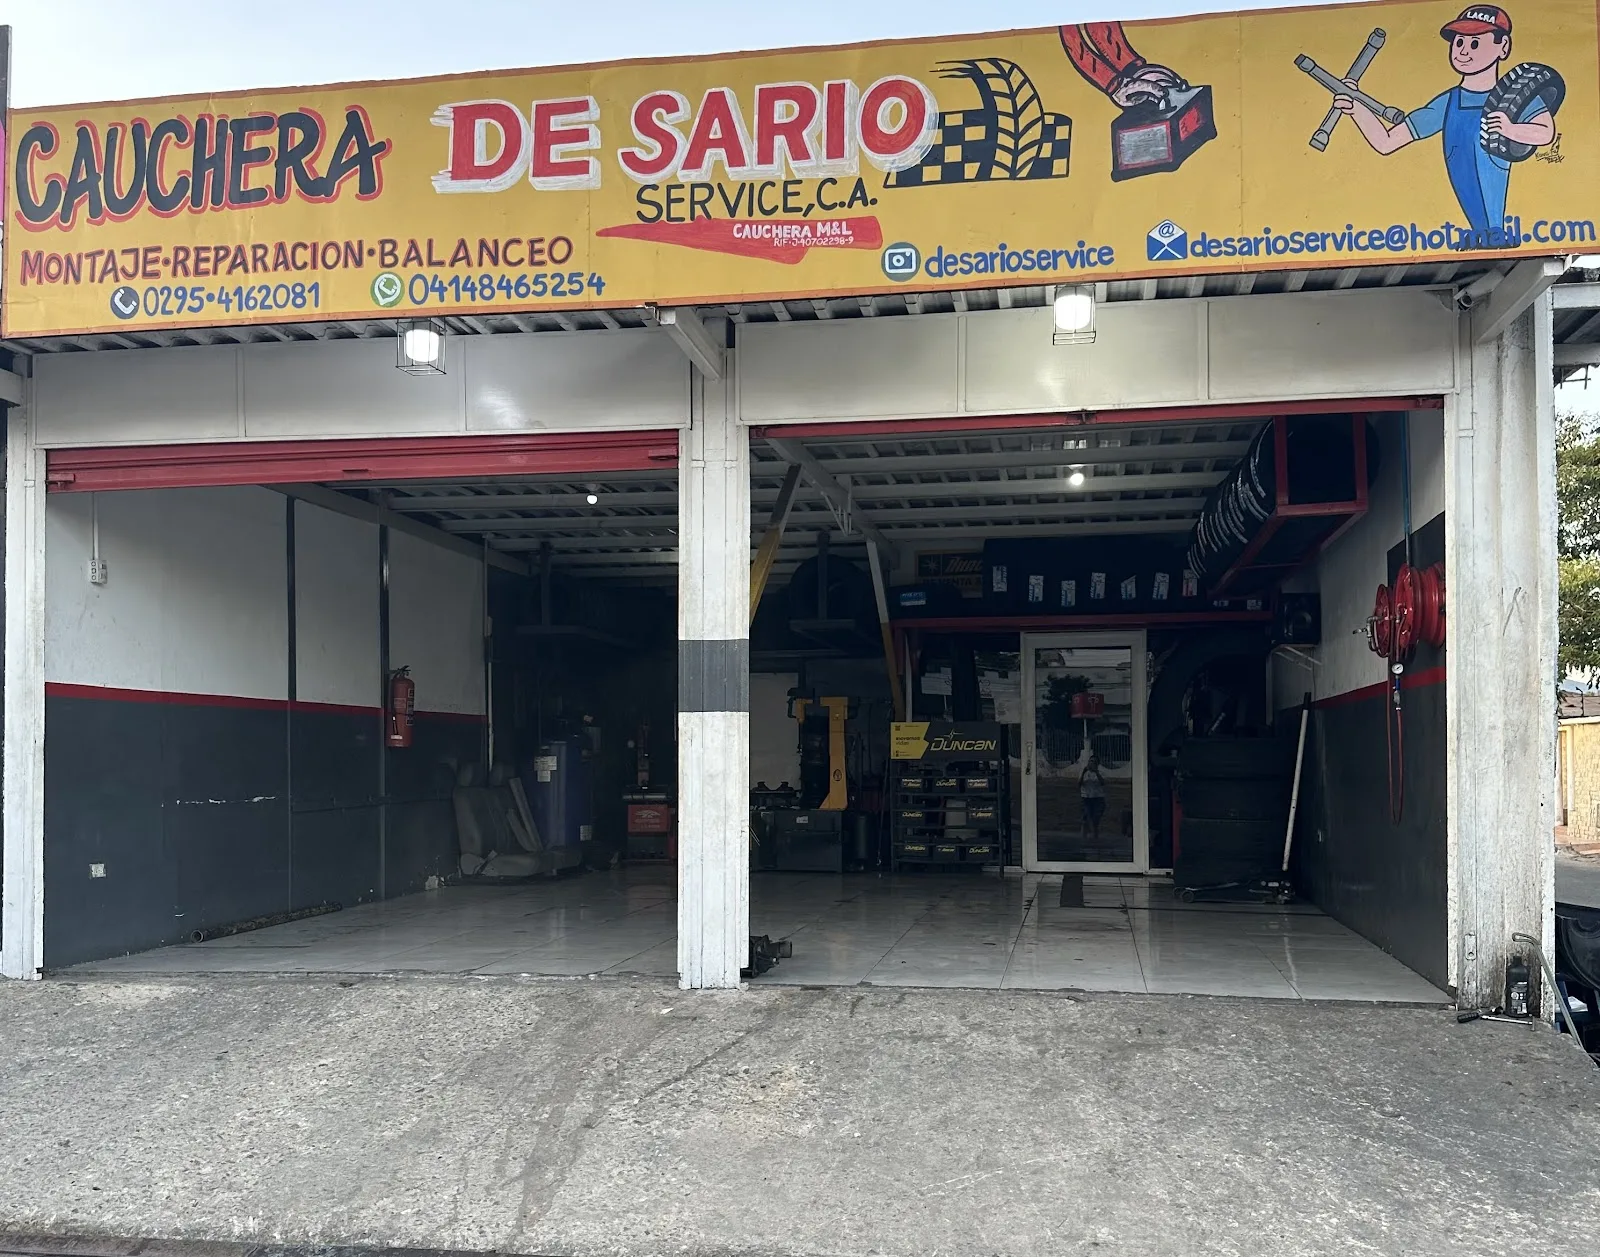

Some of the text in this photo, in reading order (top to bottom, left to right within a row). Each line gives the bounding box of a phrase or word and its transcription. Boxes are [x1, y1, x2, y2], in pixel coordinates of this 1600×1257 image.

[1466, 11, 1496, 25] LACRA
[432, 75, 938, 194] DE SARIO
[15, 105, 392, 231] CAUCHERA
[733, 220, 852, 239] CAUCHERA M&L
[1191, 215, 1596, 257] desarioservice@hotmail.com
[925, 240, 1114, 278] desarioservice
[409, 274, 606, 304] 04148465254
